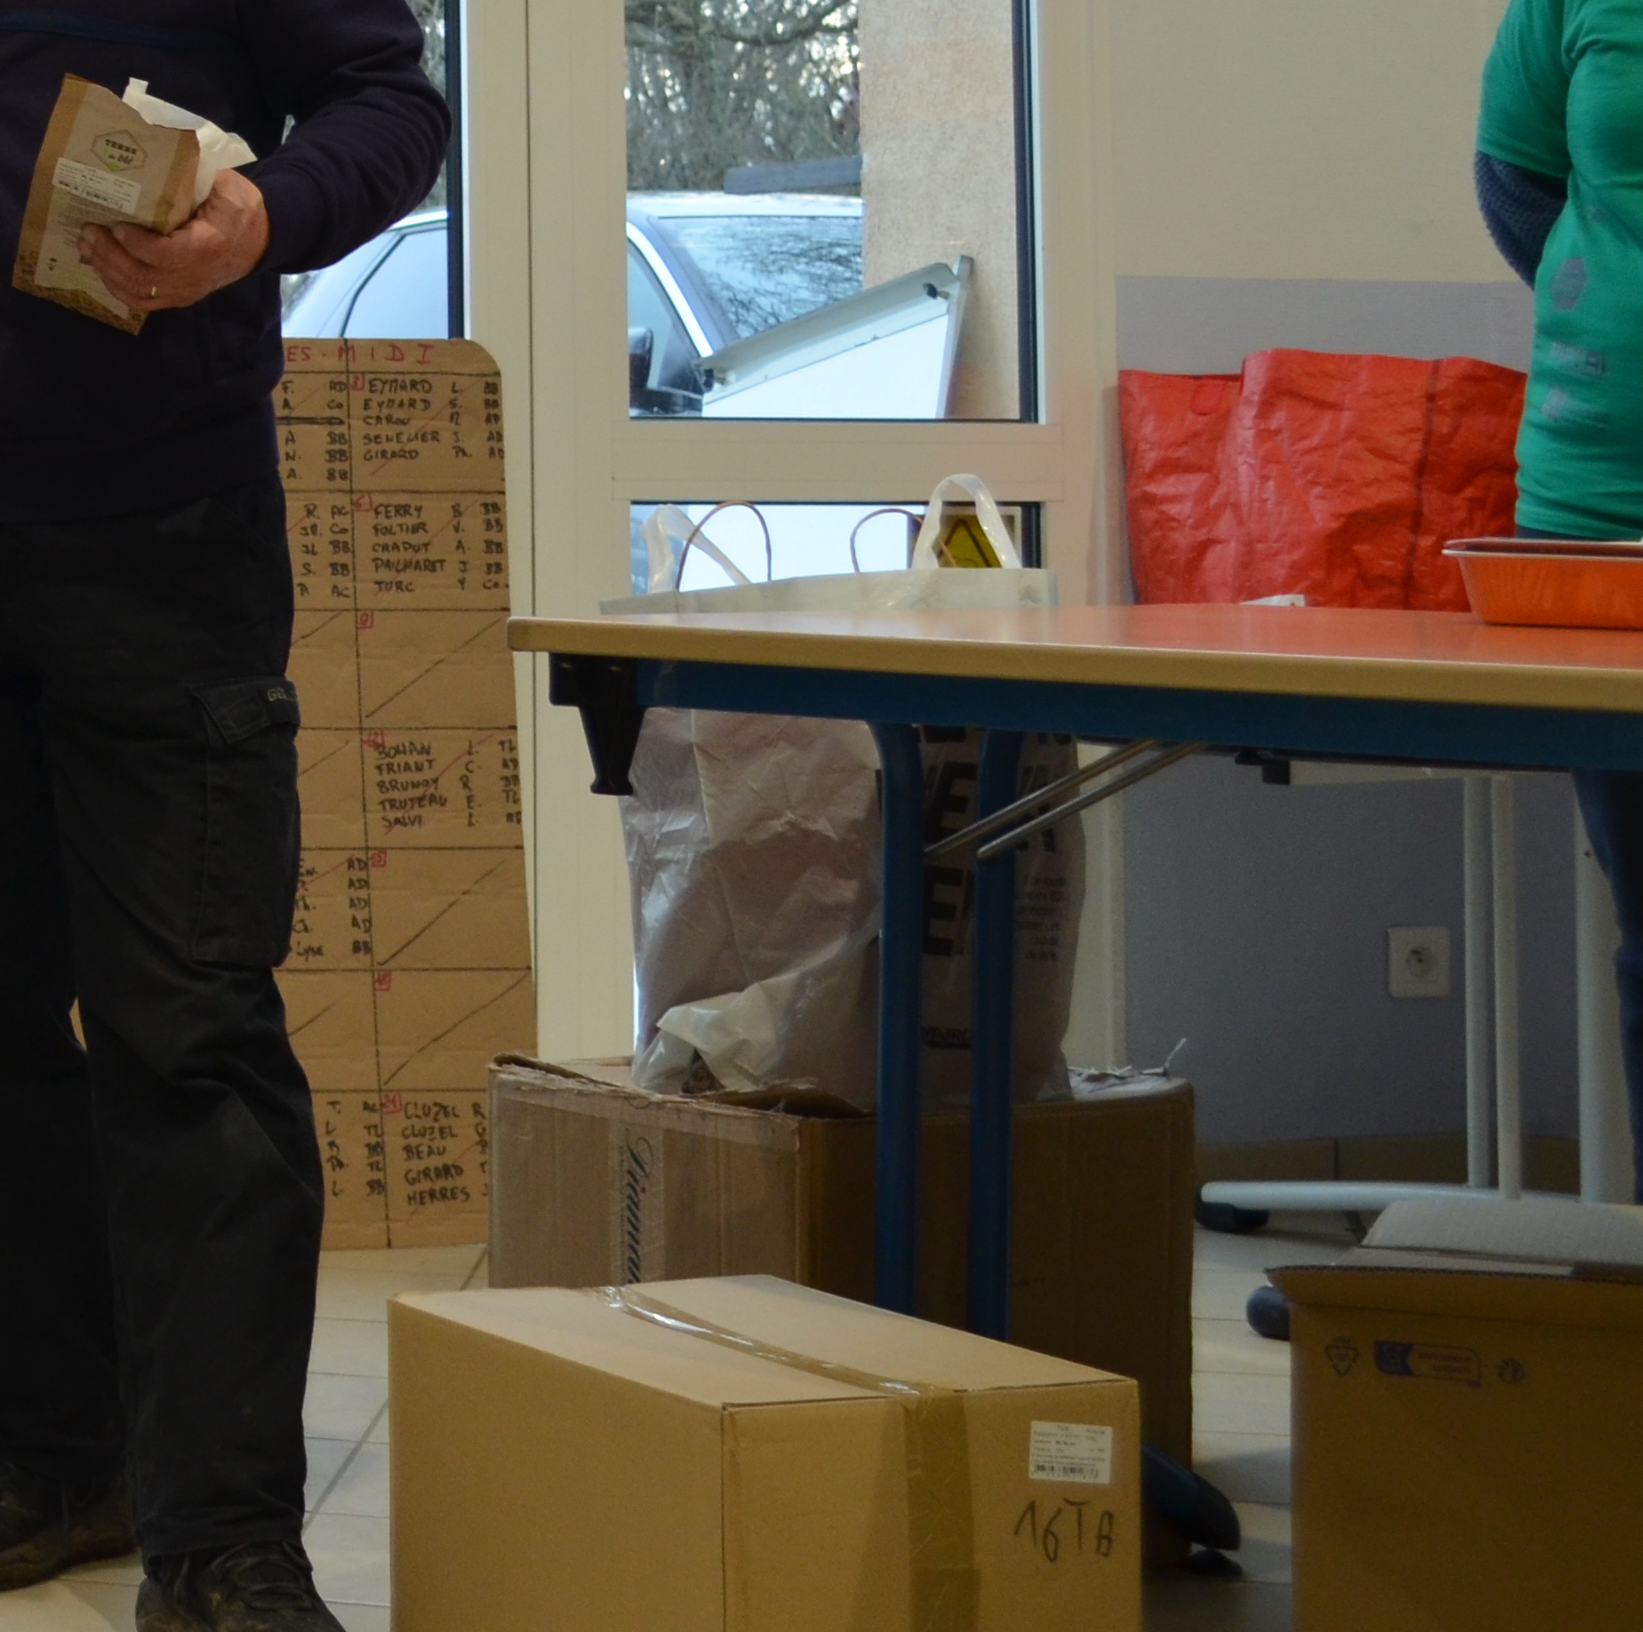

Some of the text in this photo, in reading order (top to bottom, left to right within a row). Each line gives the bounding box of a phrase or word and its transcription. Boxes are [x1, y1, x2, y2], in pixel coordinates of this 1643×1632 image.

[105, 138, 138, 156] TERRE
[373, 502, 423, 519] FERRY
[404, 1163, 465, 1187] GIRARD
[407, 1185, 471, 1206] HERRES
